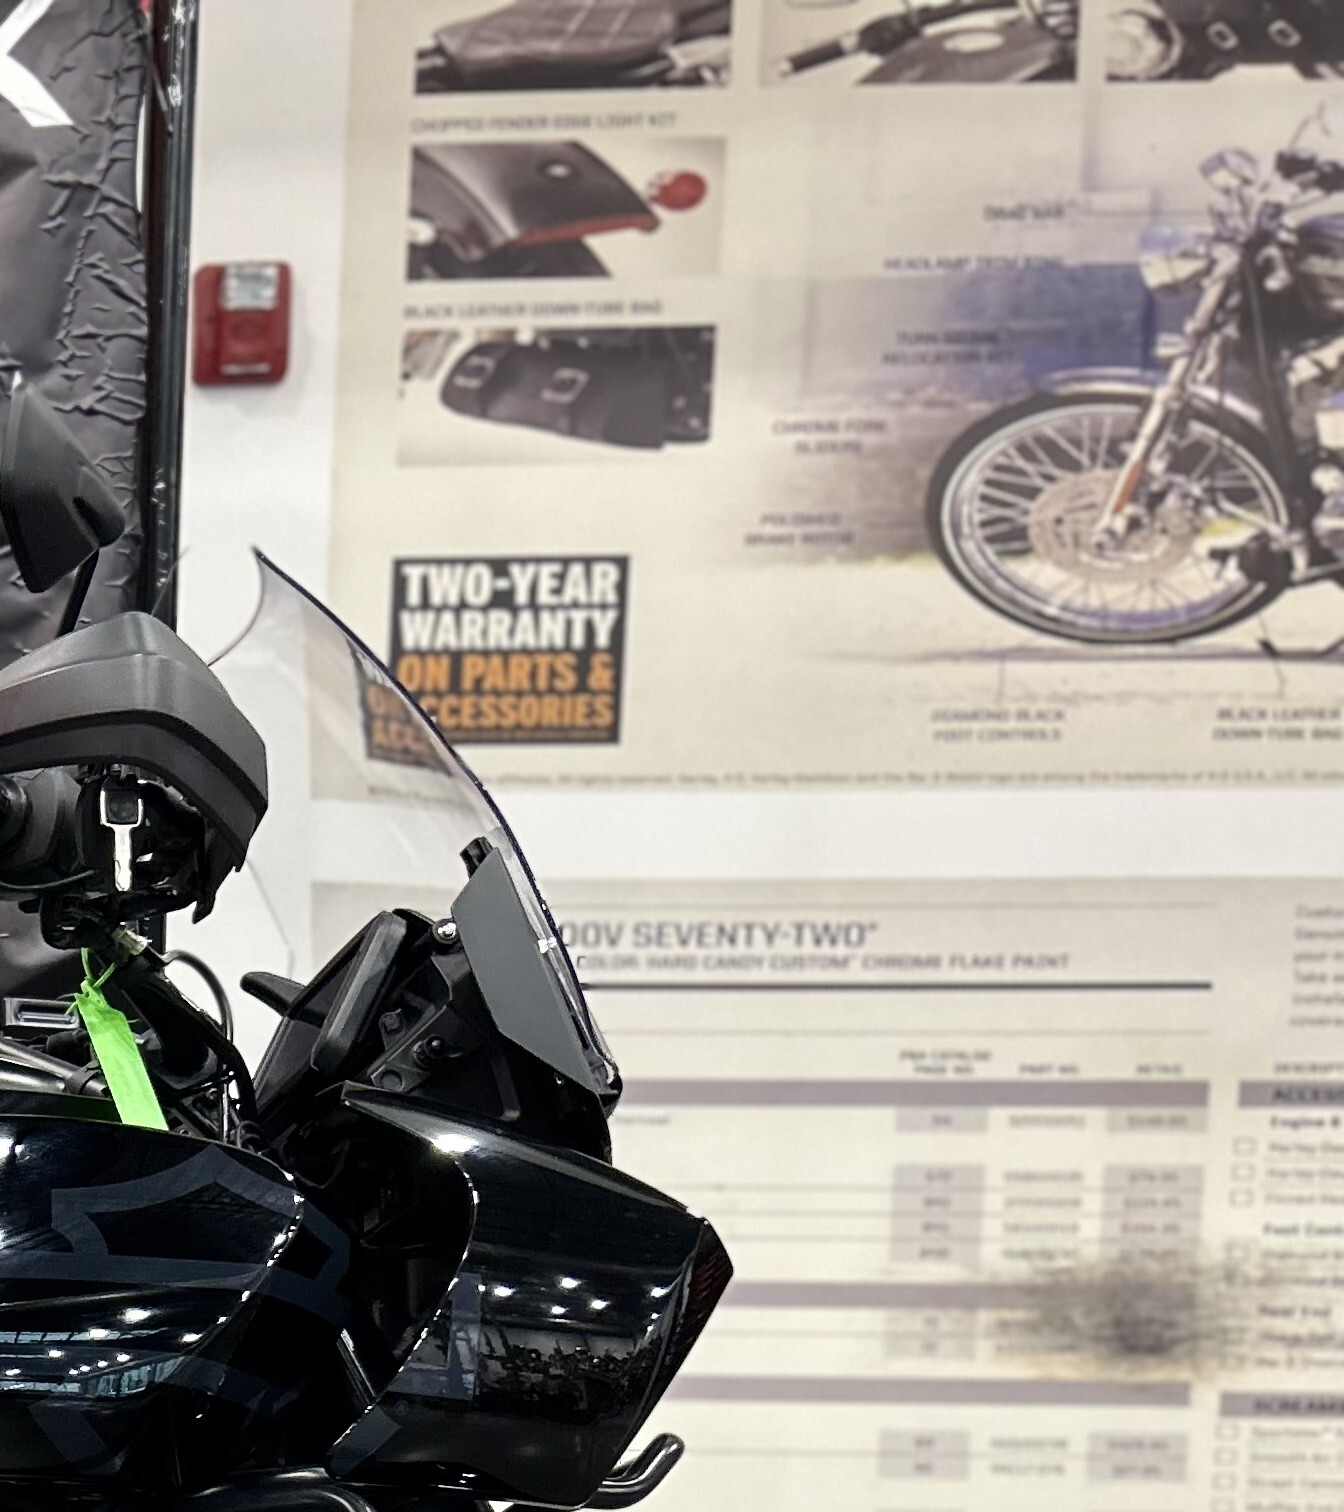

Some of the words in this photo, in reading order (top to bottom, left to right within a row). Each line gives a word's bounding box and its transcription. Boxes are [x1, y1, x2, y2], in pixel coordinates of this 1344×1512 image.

[400, 560, 621, 608] TWO-YEAR
[399, 608, 618, 651] WARRANTY
[397, 653, 450, 692] ON
[461, 652, 578, 692] PARTS
[587, 652, 616, 691] &
